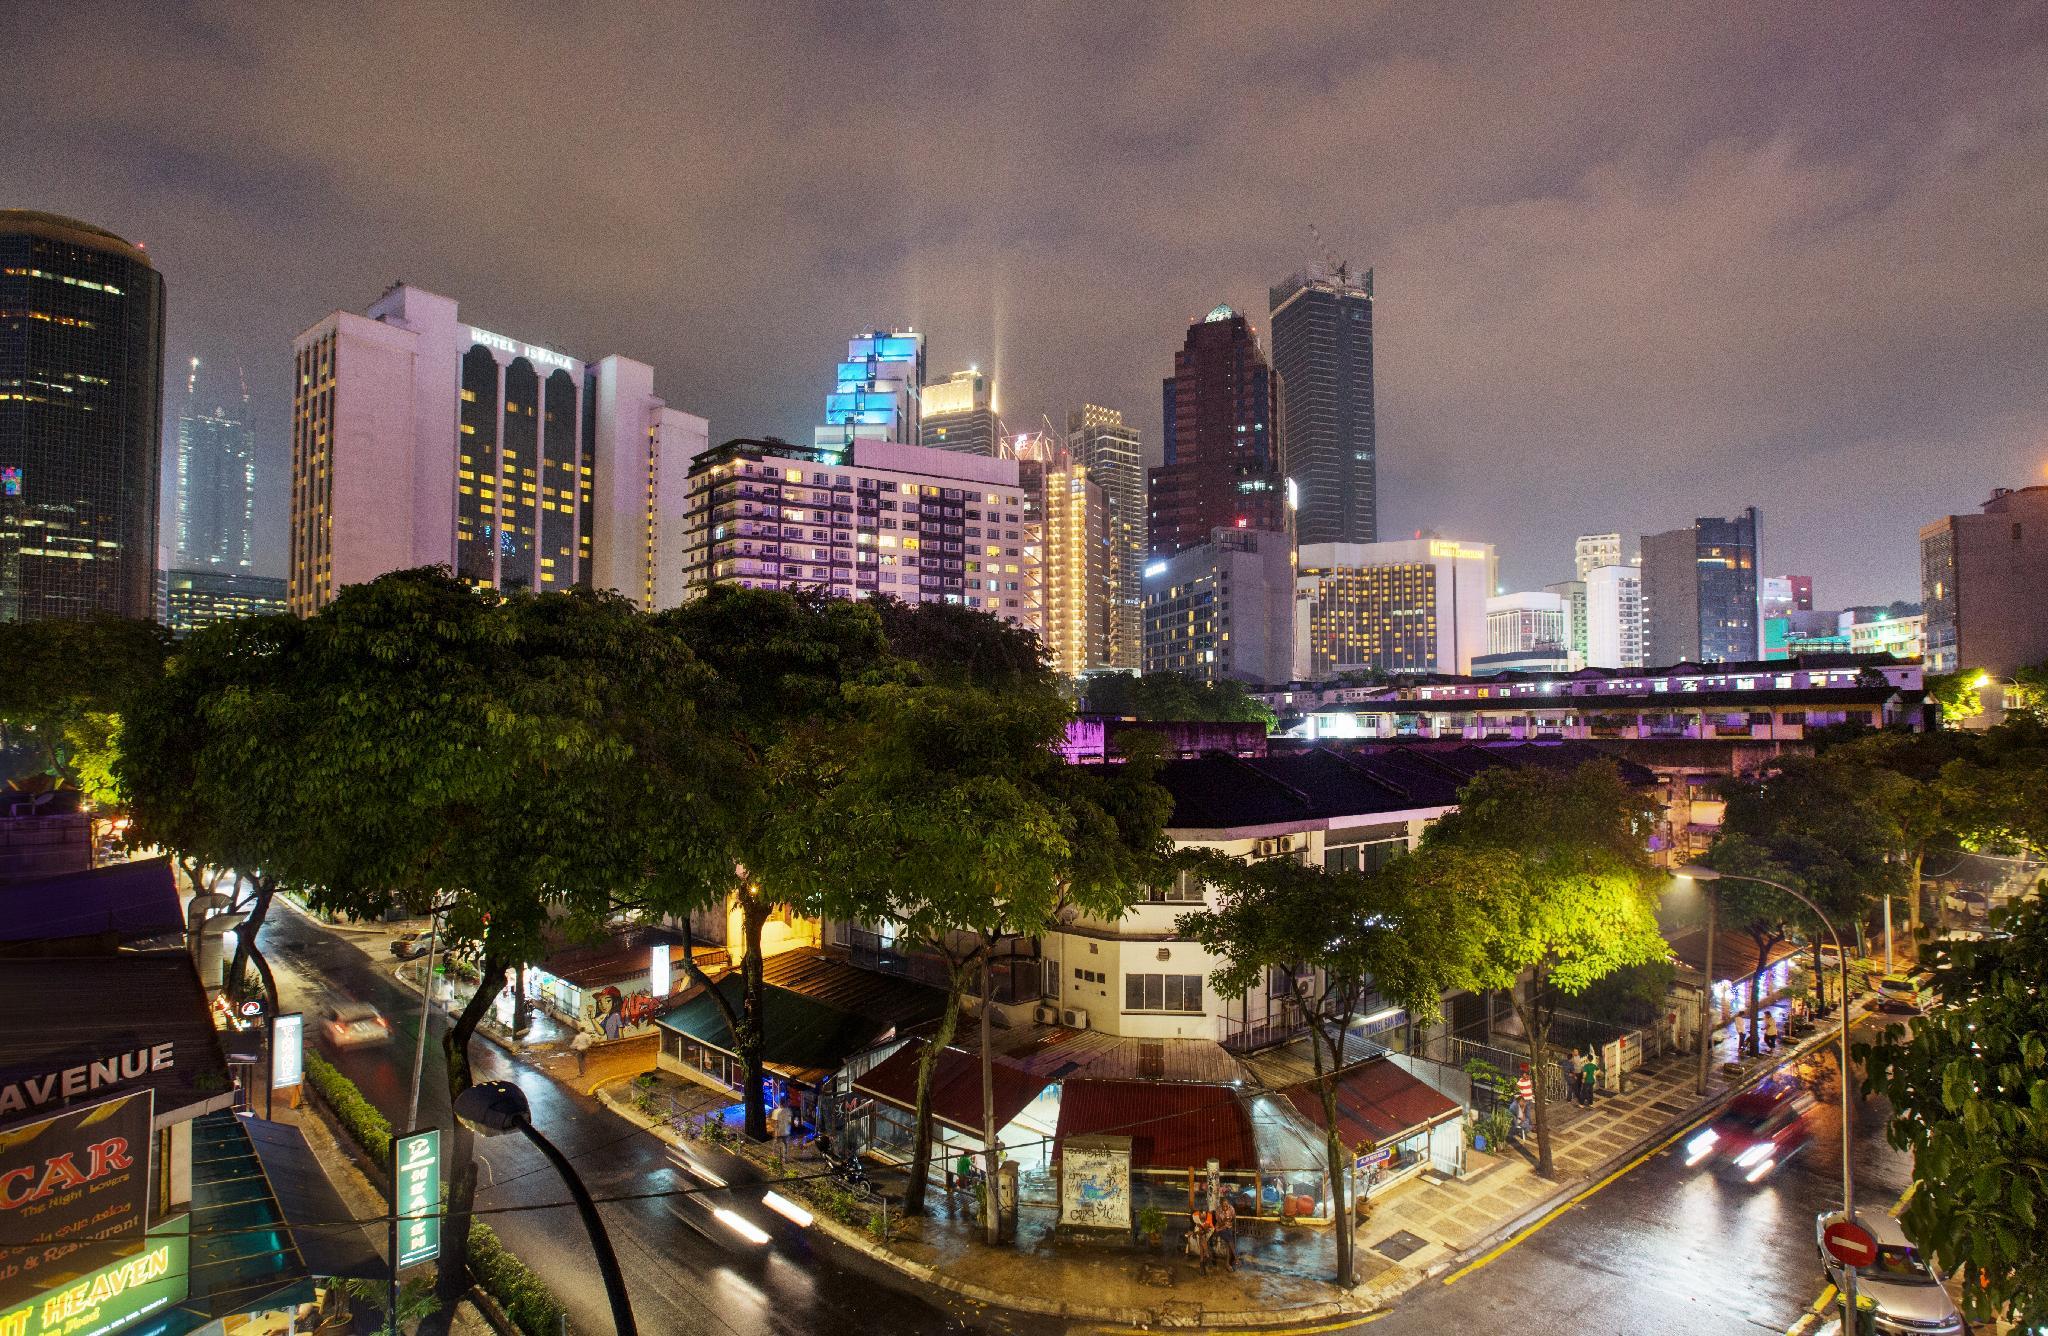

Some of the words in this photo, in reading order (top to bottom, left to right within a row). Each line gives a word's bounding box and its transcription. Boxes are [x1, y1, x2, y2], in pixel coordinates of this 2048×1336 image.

[471, 326, 516, 353] HOTEL
[0, 1041, 174, 1115] AVENUE
[41, 1245, 169, 1329] HEAVEN
